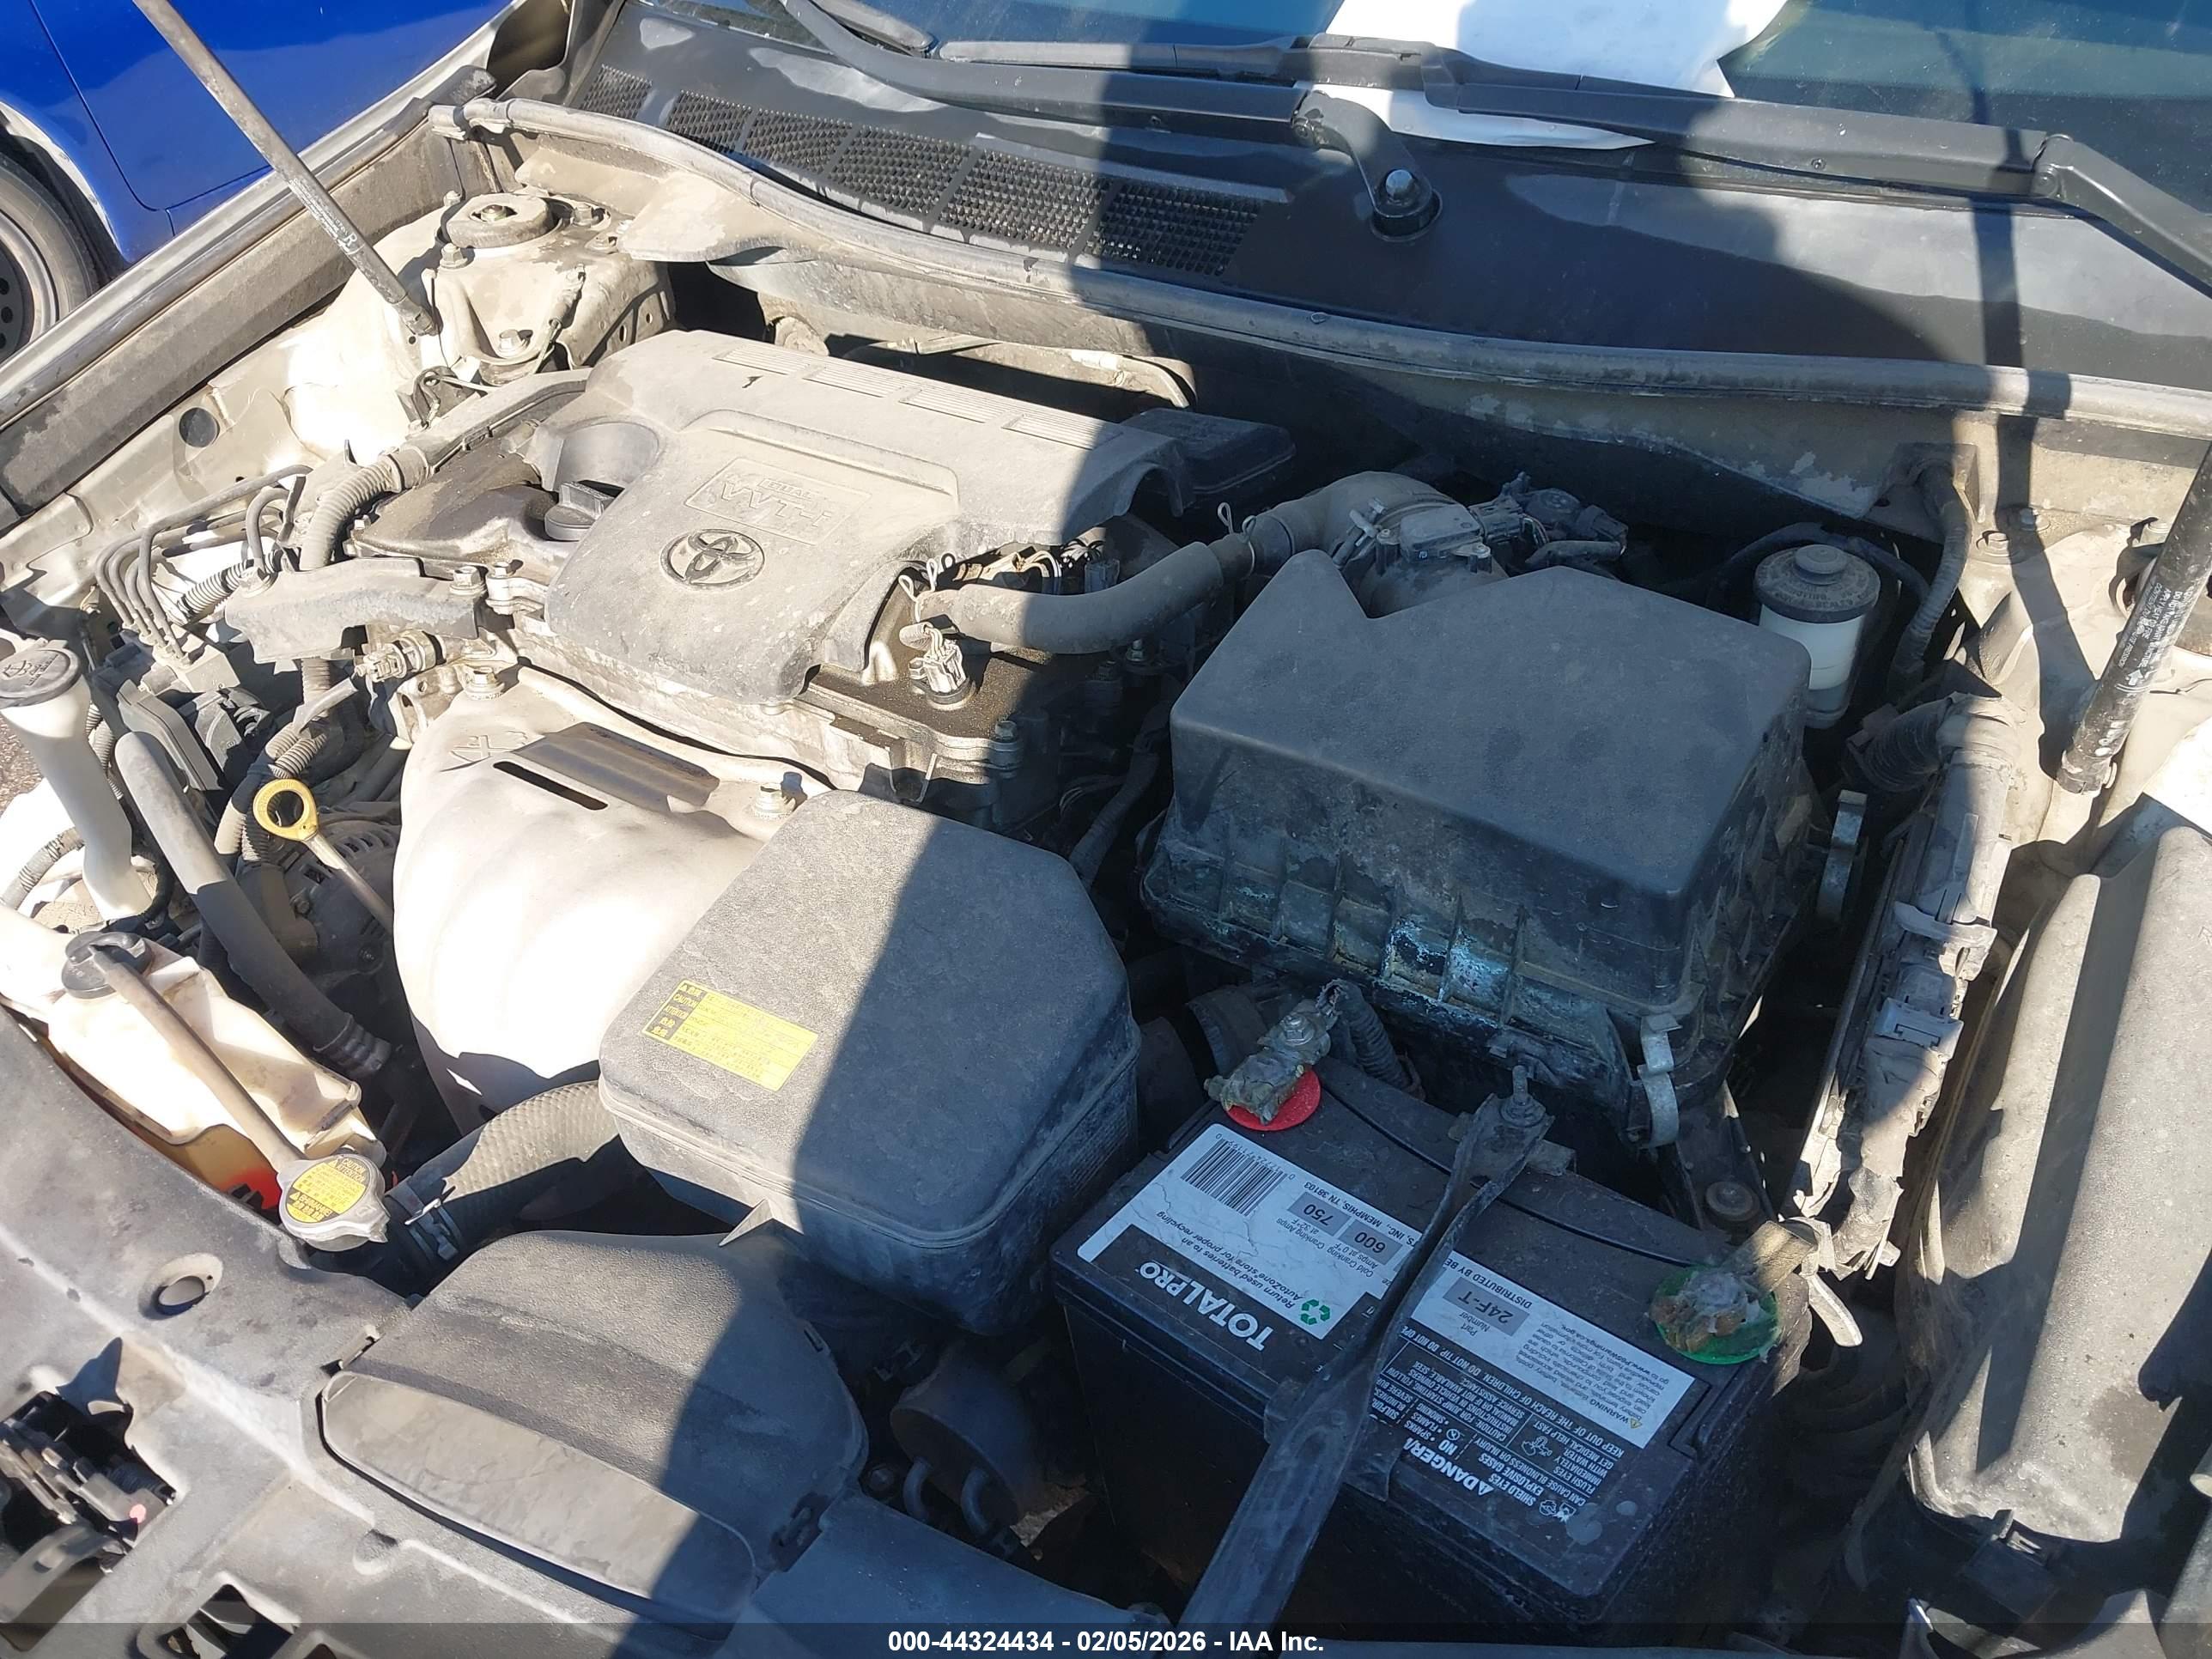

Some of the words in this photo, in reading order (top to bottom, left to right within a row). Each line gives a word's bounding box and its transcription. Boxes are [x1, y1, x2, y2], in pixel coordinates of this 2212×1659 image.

[343, 232, 357, 246] R
[672, 991, 697, 1008] CAUTION
[1302, 1181, 1330, 1198] 38103
[1328, 1194, 1341, 1204] TN
[1300, 1202, 1336, 1226] 750
[1339, 1200, 1383, 1227] MEMPHIS,
[1154, 1210, 1195, 1237] recycling
[1274, 1217, 1297, 1232] Amps
[1178, 1237, 1194, 1249] an
[1191, 1231, 1224, 1253] proper
[1292, 1228, 1327, 1249] Cranking
[1352, 1231, 1388, 1255] 600
[1190, 1243, 1203, 1255] to
[1219, 1250, 1235, 1261] for
[1324, 1246, 1358, 1268] Cranking
[1200, 1249, 1242, 1277] batteries
[1233, 1258, 1260, 1276] store
[1354, 1253, 1379, 1269] Amps
[1355, 1264, 1375, 1278] Cold
[1456, 1265, 1473, 1277] BY
[1237, 1272, 1264, 1290] used
[1471, 1272, 1533, 1309] DISTRIBUTED
[1133, 1255, 1279, 1351] TOTALPRO
[1261, 1285, 1297, 1309] Return
[1456, 1288, 1514, 1325] 24F-T
[1457, 1310, 1491, 1332] Number
[1459, 1322, 1478, 1336] Part
[1398, 1325, 1417, 1339] OPE
[1412, 1332, 1431, 1346] NOT
[1425, 1340, 1440, 1352] DO
[1411, 1360, 1431, 1374] SEEK
[1450, 1354, 1471, 1370] NOT
[1466, 1363, 1482, 1376] DO
[1384, 1365, 1413, 1386] FOLLOW
[1406, 1368, 1437, 1389] OWNERS
[1386, 1383, 1414, 1403] SEVERE
[1409, 1380, 1444, 1405] STARTING,
[1431, 1382, 1462, 1403] VEHICLE
[1459, 1388, 1477, 1401] NOT
[1473, 1396, 1484, 1406] IF
[1517, 1393, 1534, 1406] OF
[1440, 1399, 1462, 1415] JUMP
[1456, 1397, 1469, 1408] IN
[1480, 1400, 1494, 1412] OR
[1495, 1398, 1526, 1419] SERVICE
[1530, 1400, 1559, 1420] REACH
[1589, 1397, 1630, 1424] WARNING
[1409, 1411, 1439, 1431] FLAMES
[1414, 1401, 1447, 1424] SMOKING
[1458, 1409, 1475, 1423] FOR
[1464, 1402, 1514, 1434] INSTRUCTIONS
[1489, 1406, 1520, 1426] MANUAL
[1554, 1413, 1576, 1430] THE
[1402, 1419, 1432, 1440] SPARKS
[1473, 1418, 1508, 1442] CAUTION:
[1549, 1429, 1571, 1445] HELP
[1571, 1424, 1588, 1437] OF
[1583, 1430, 1605, 1447] OUT
[1436, 1437, 1458, 1455] NO
[1473, 1436, 1502, 1456] INJURY
[1567, 1439, 1600, 1462] MEDICAL
[1600, 1439, 1625, 1458] KEEP
[1477, 1451, 1505, 1473] GASES
[1497, 1450, 1512, 1462] OR
[1595, 1455, 1614, 1470] GET
[1508, 1456, 1548, 1485] BLINDNESS
[1552, 1464, 1573, 1481] EYES
[1553, 1454, 1601, 1486] IMMEDIATELY
[1486, 1472, 1510, 1491] EYES
[1500, 1466, 1545, 1496] EXPLOSIVE
[1545, 1479, 1571, 1498] CAUSE
[1570, 1475, 1595, 1494] FLUSH
[1506, 1484, 1536, 1506] SHIELD
[1567, 1492, 1586, 1507] CAN
